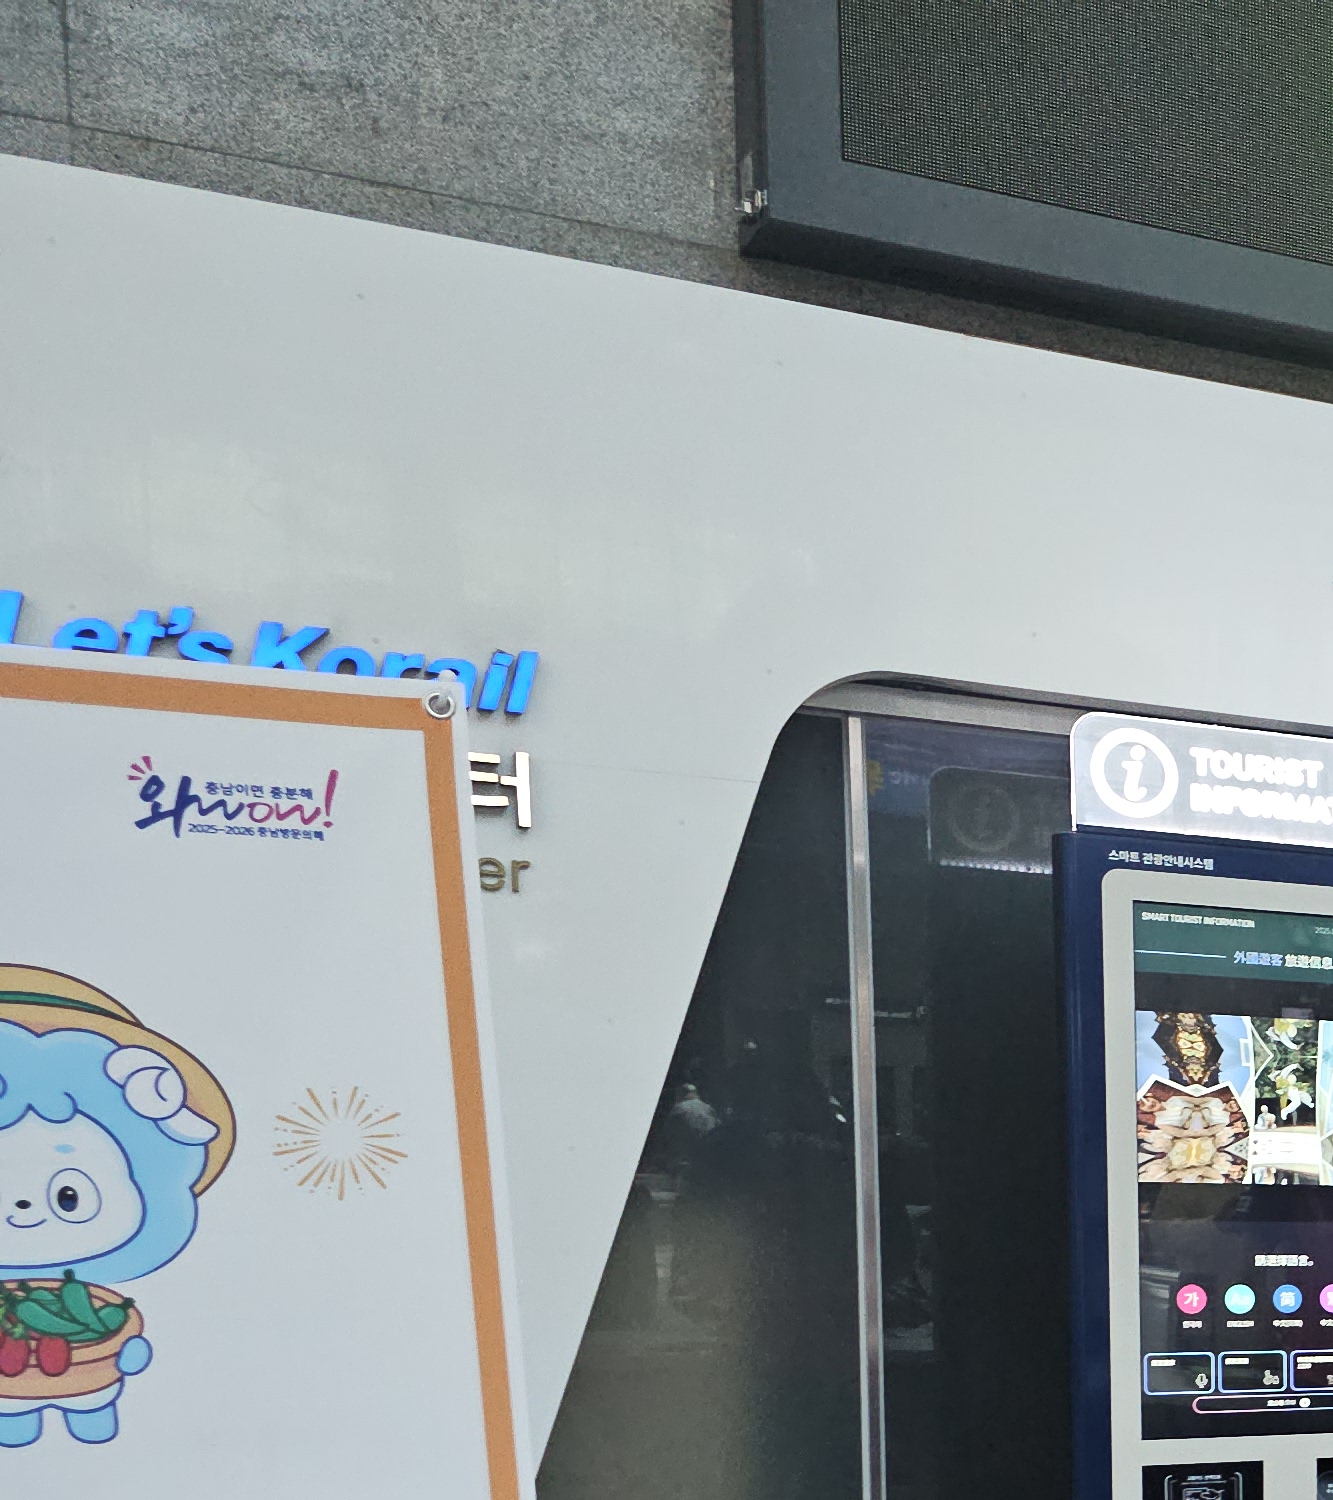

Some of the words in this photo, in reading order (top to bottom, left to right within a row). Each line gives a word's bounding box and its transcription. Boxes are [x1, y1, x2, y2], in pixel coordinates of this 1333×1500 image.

[1189, 746, 1324, 789] TOURIST
[1108, 849, 1141, 862] 스마트
[1141, 911, 1170, 922] SMART
[1170, 913, 1203, 925] TOURIST
[1203, 916, 1256, 929] INFORMATION
[1183, 1291, 1200, 1307] 가
